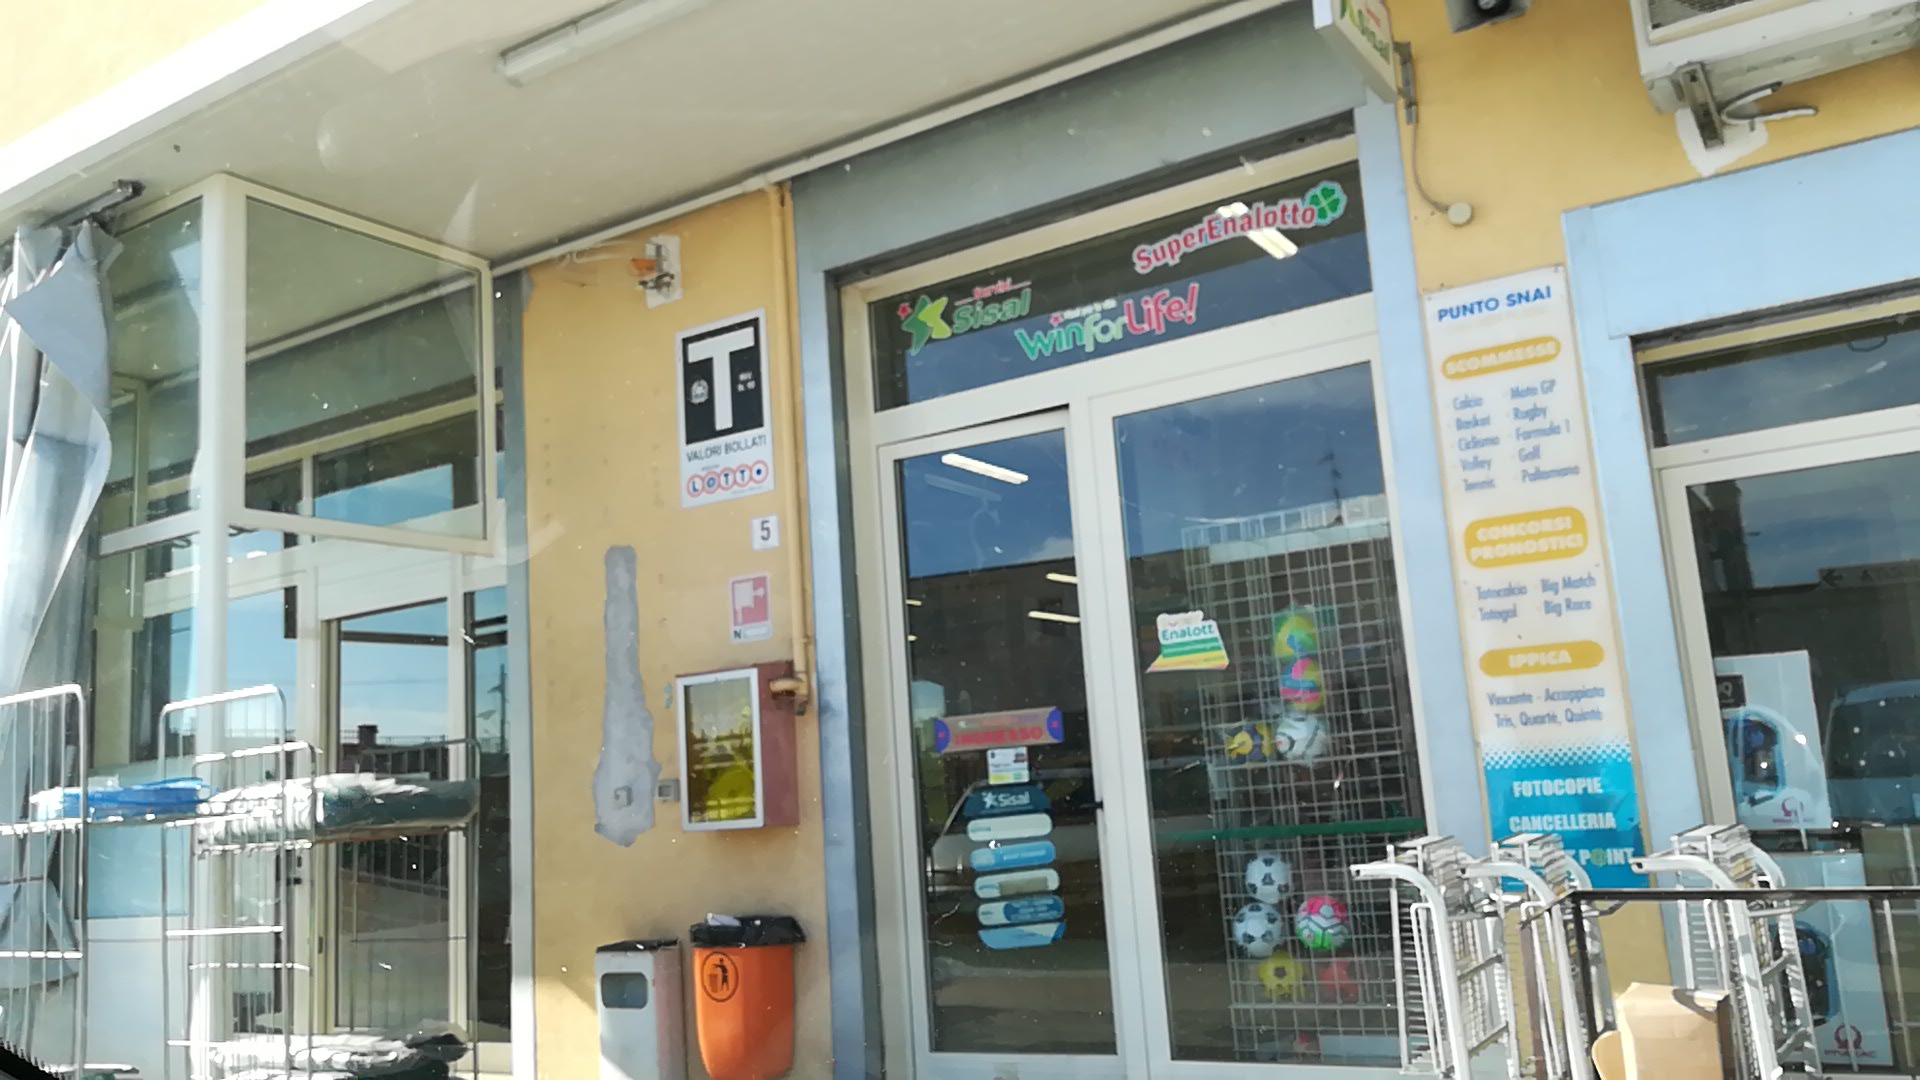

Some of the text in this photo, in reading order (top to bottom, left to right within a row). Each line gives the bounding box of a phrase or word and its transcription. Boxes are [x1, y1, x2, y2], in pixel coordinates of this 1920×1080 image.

[1133, 202, 1317, 274] SuperEnalotto
[953, 287, 1031, 333] Sisal
[1438, 286, 1552, 322] PUNTO SNAI
[1446, 341, 1557, 375] SCOMMESSE
[1513, 403, 1548, 422] Rugby
[1516, 421, 1561, 440] Formula
[687, 434, 767, 462] VALORI BOLLATI
[760, 520, 771, 541] 5
[1477, 515, 1572, 542] CONCORSI
[1471, 533, 1583, 562] PRONOSTICI
[1541, 579, 1559, 596] Big
[1544, 600, 1562, 617] Big
[1508, 649, 1572, 669] IPPICA
[1512, 777, 1603, 798] FOTOCOPIE
[1509, 812, 1616, 833] CANCELLERIA
